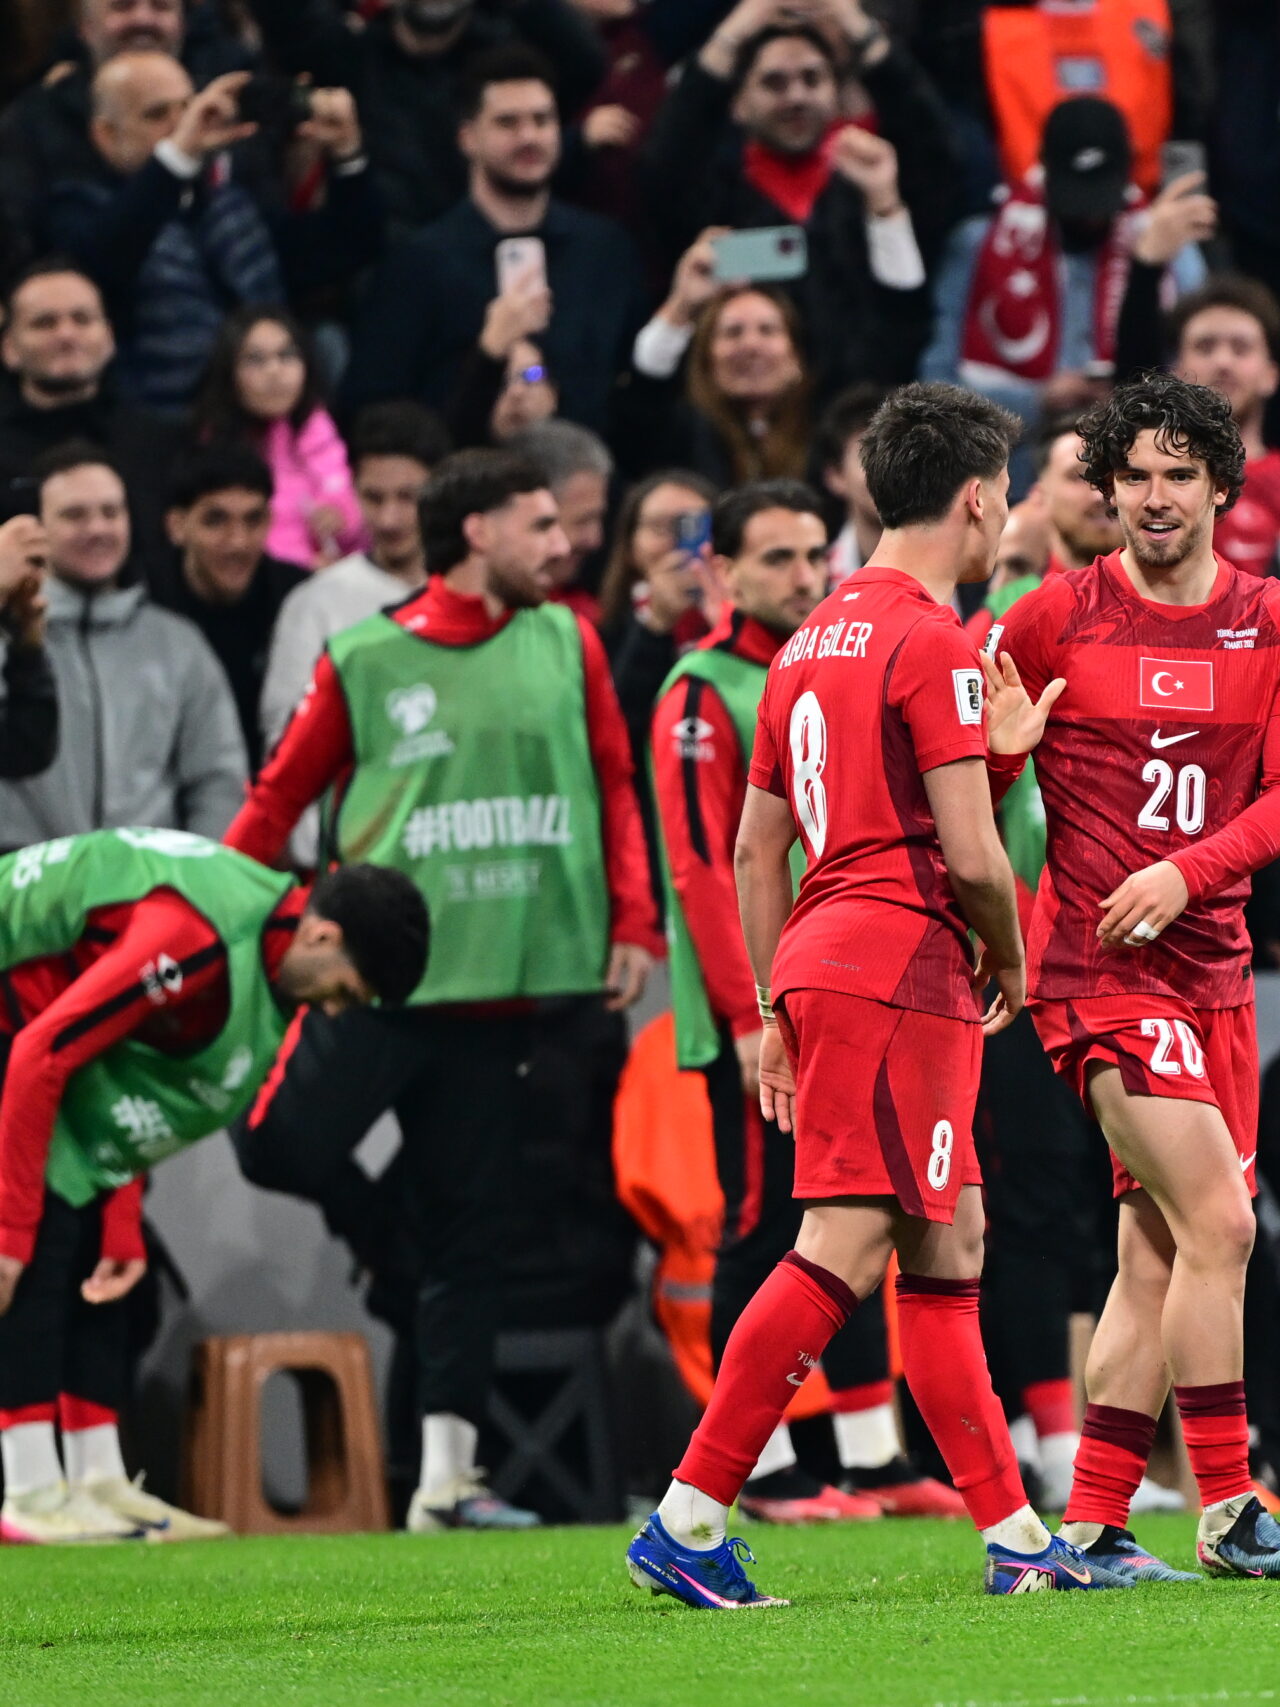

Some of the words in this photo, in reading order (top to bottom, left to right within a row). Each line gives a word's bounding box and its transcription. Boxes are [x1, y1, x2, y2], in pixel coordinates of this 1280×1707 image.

[778, 626, 821, 670] ARDA
[817, 617, 873, 659] GÜLER
[789, 690, 827, 860] 8
[1137, 758, 1206, 835] 20
[1140, 1017, 1205, 1079] 20
[927, 1119, 954, 1191] 8
